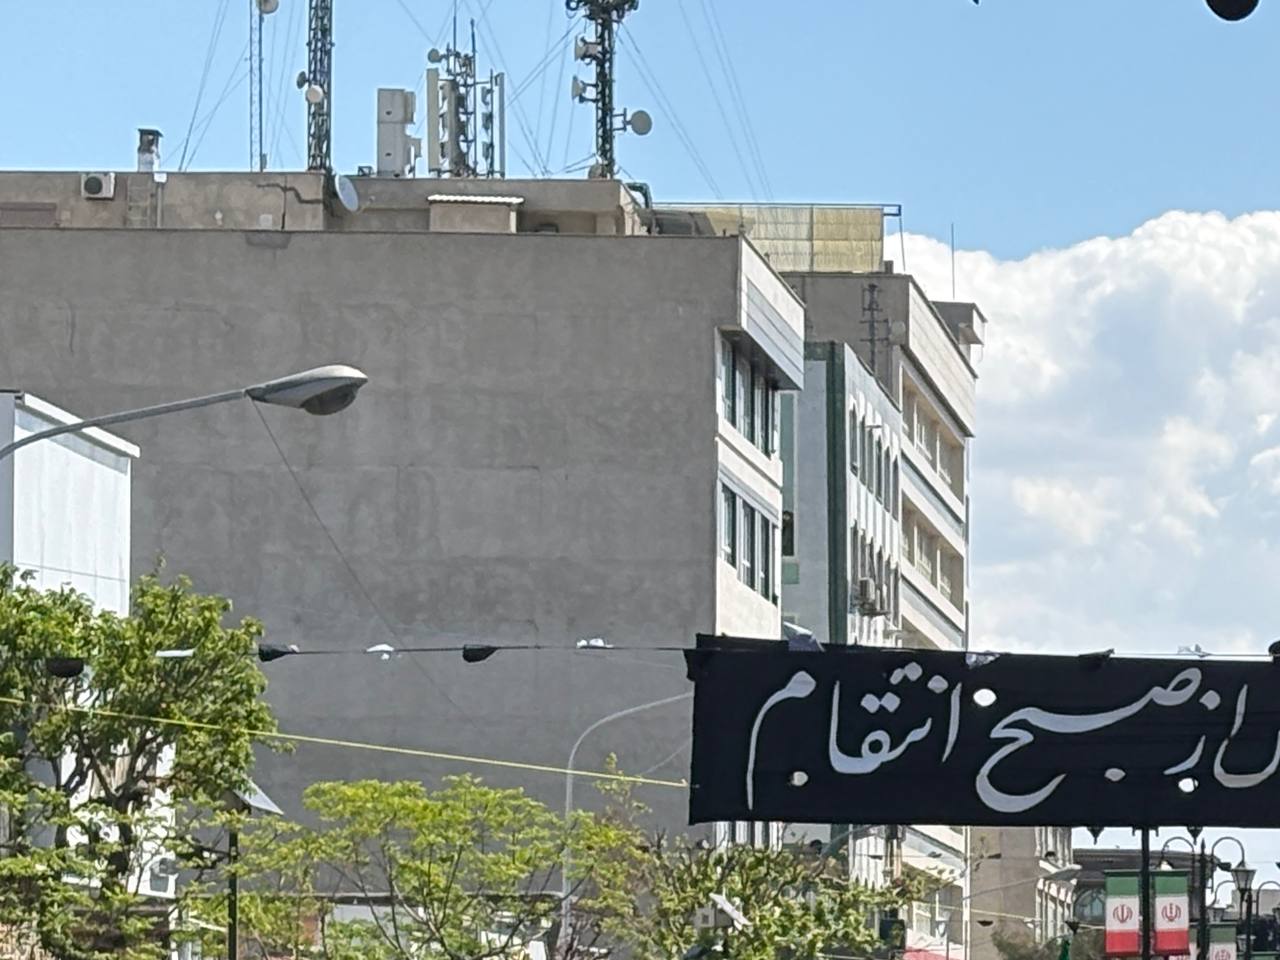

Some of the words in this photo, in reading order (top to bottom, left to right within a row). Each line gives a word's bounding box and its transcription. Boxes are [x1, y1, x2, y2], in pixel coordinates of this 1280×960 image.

[746, 661, 962, 811] انتقام
[975, 667, 1202, 813] صبح
[1165, 684, 1248, 776] از
